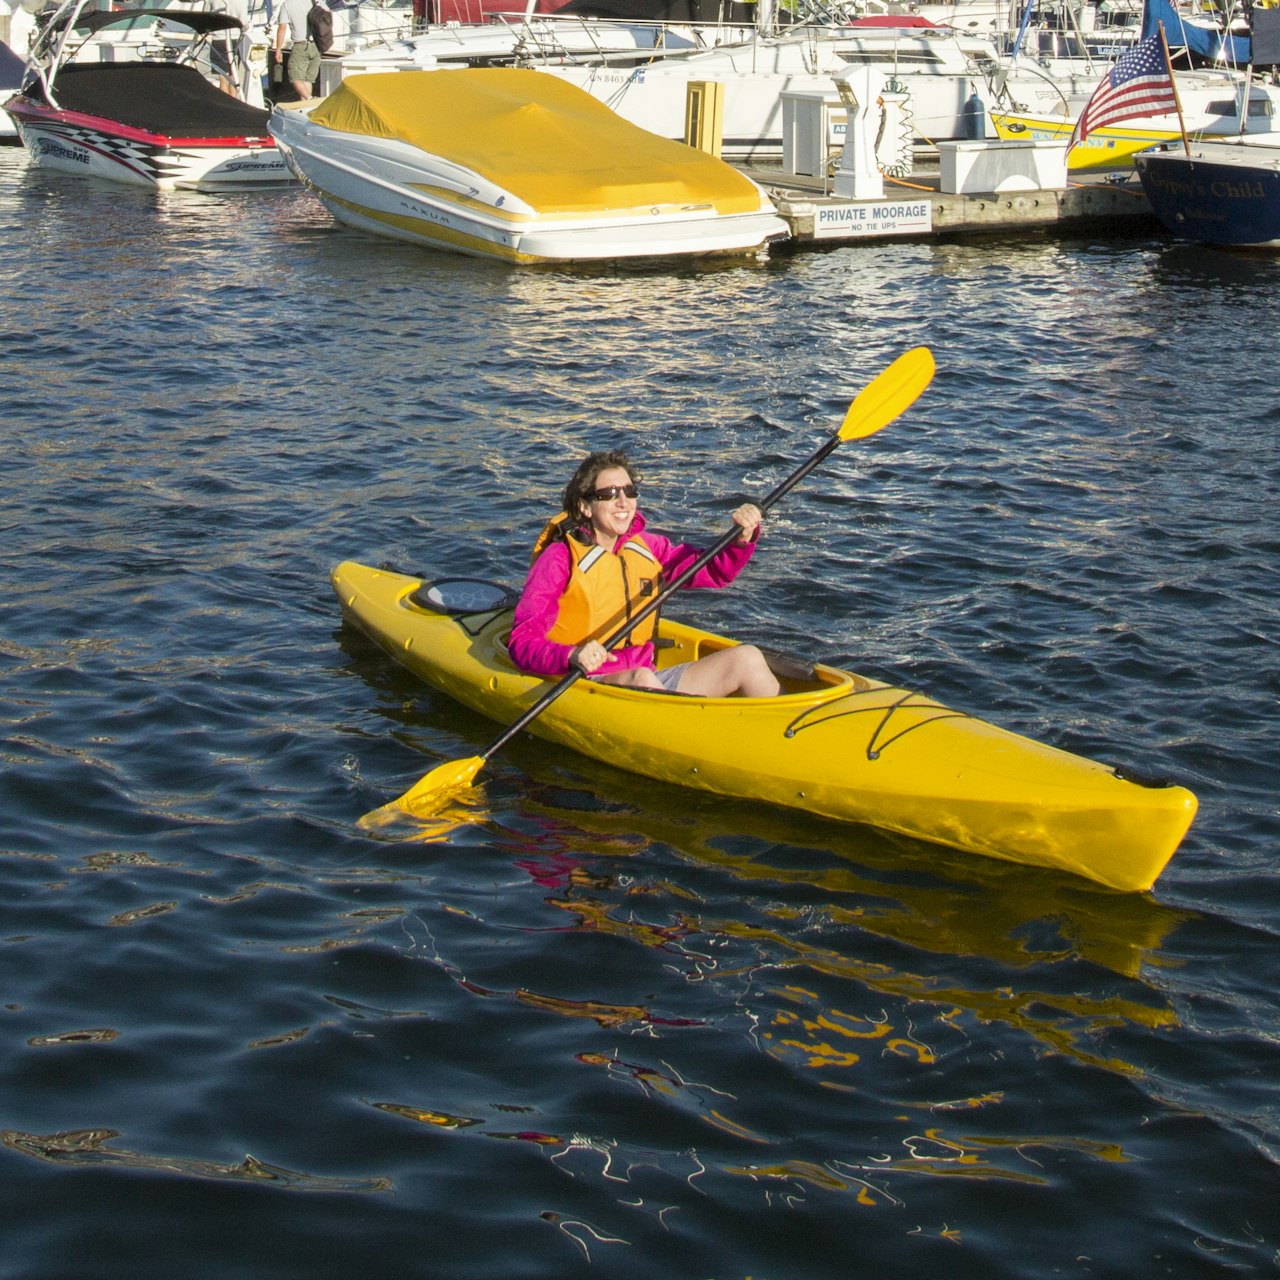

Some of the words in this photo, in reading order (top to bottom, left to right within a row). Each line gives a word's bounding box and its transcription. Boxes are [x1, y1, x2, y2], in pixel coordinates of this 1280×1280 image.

[37, 137, 90, 164] SUPREME
[220, 161, 287, 173] SUPREME
[1210, 181, 1266, 198] Child
[400, 201, 450, 223] MAXUM
[820, 208, 866, 222] PRIVATE
[872, 205, 927, 220] MOORAGE
[881, 222, 896, 230] UPS
